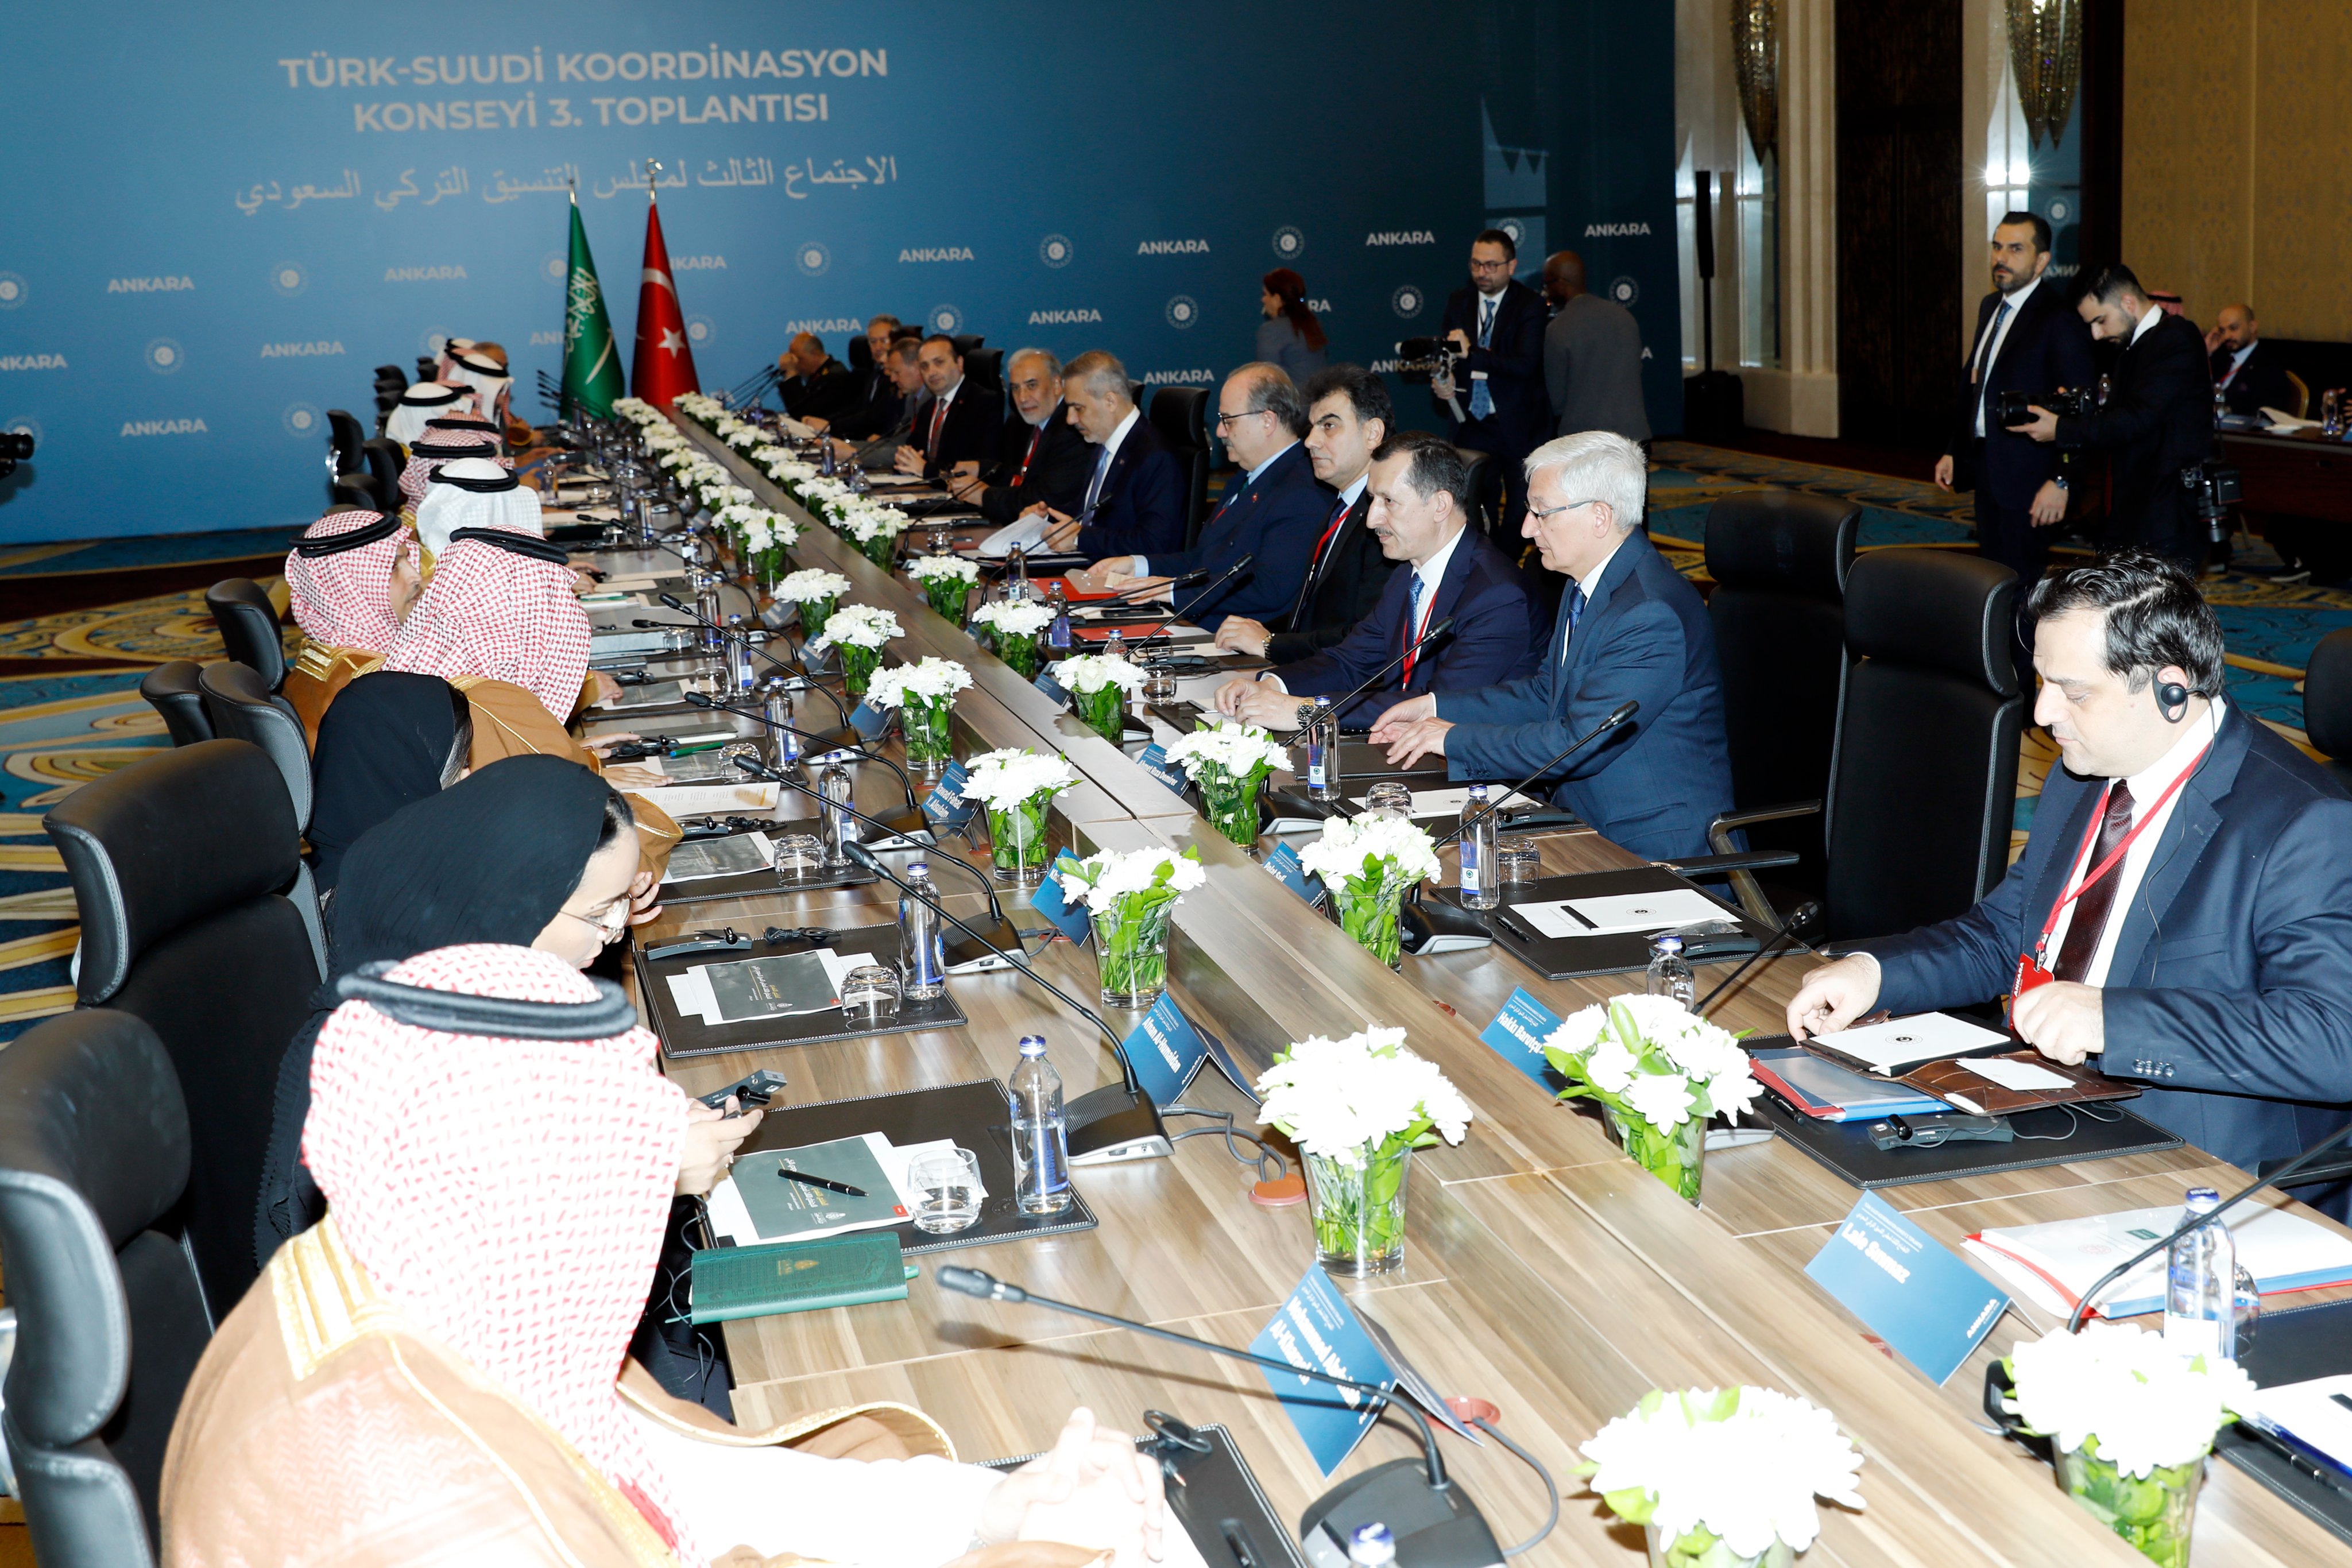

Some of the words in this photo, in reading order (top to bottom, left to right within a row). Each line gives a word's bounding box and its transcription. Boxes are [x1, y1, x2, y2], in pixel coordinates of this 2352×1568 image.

[278, 46, 545, 88] TÜRK-SUUDİ
[558, 42, 887, 83] KOORDİNASYON
[354, 91, 537, 133] KONSEYİ
[548, 98, 582, 127] 3.
[592, 93, 828, 125] TOPLANTISI
[697, 157, 774, 187] الثالث
[784, 156, 897, 199] الاجتماع
[235, 168, 362, 216] السعودي
[374, 165, 470, 212] التركي
[483, 162, 581, 204] التنسيق
[1366, 230, 1434, 246] ANKARA
[1585, 222, 1651, 237] ANKARA
[899, 247, 975, 263] ANKARA
[1138, 239, 1210, 255] ANKARA
[670, 255, 727, 270] KARA
[385, 264, 468, 281] ANKARA
[107, 275, 195, 293] ANKARA
[785, 318, 862, 334] ANKARA
[1028, 309, 1102, 325] ANKARA
[260, 340, 346, 358] ANKARA
[0, 353, 68, 371] NKARA
[1143, 369, 1214, 384] ANKARA
[121, 417, 208, 437] ANKARA
[2014, 962, 2025, 998] ANKARA
[1514, 1025, 1544, 1054] Barutçu
[1966, 1299, 1998, 1339] ANKARA
